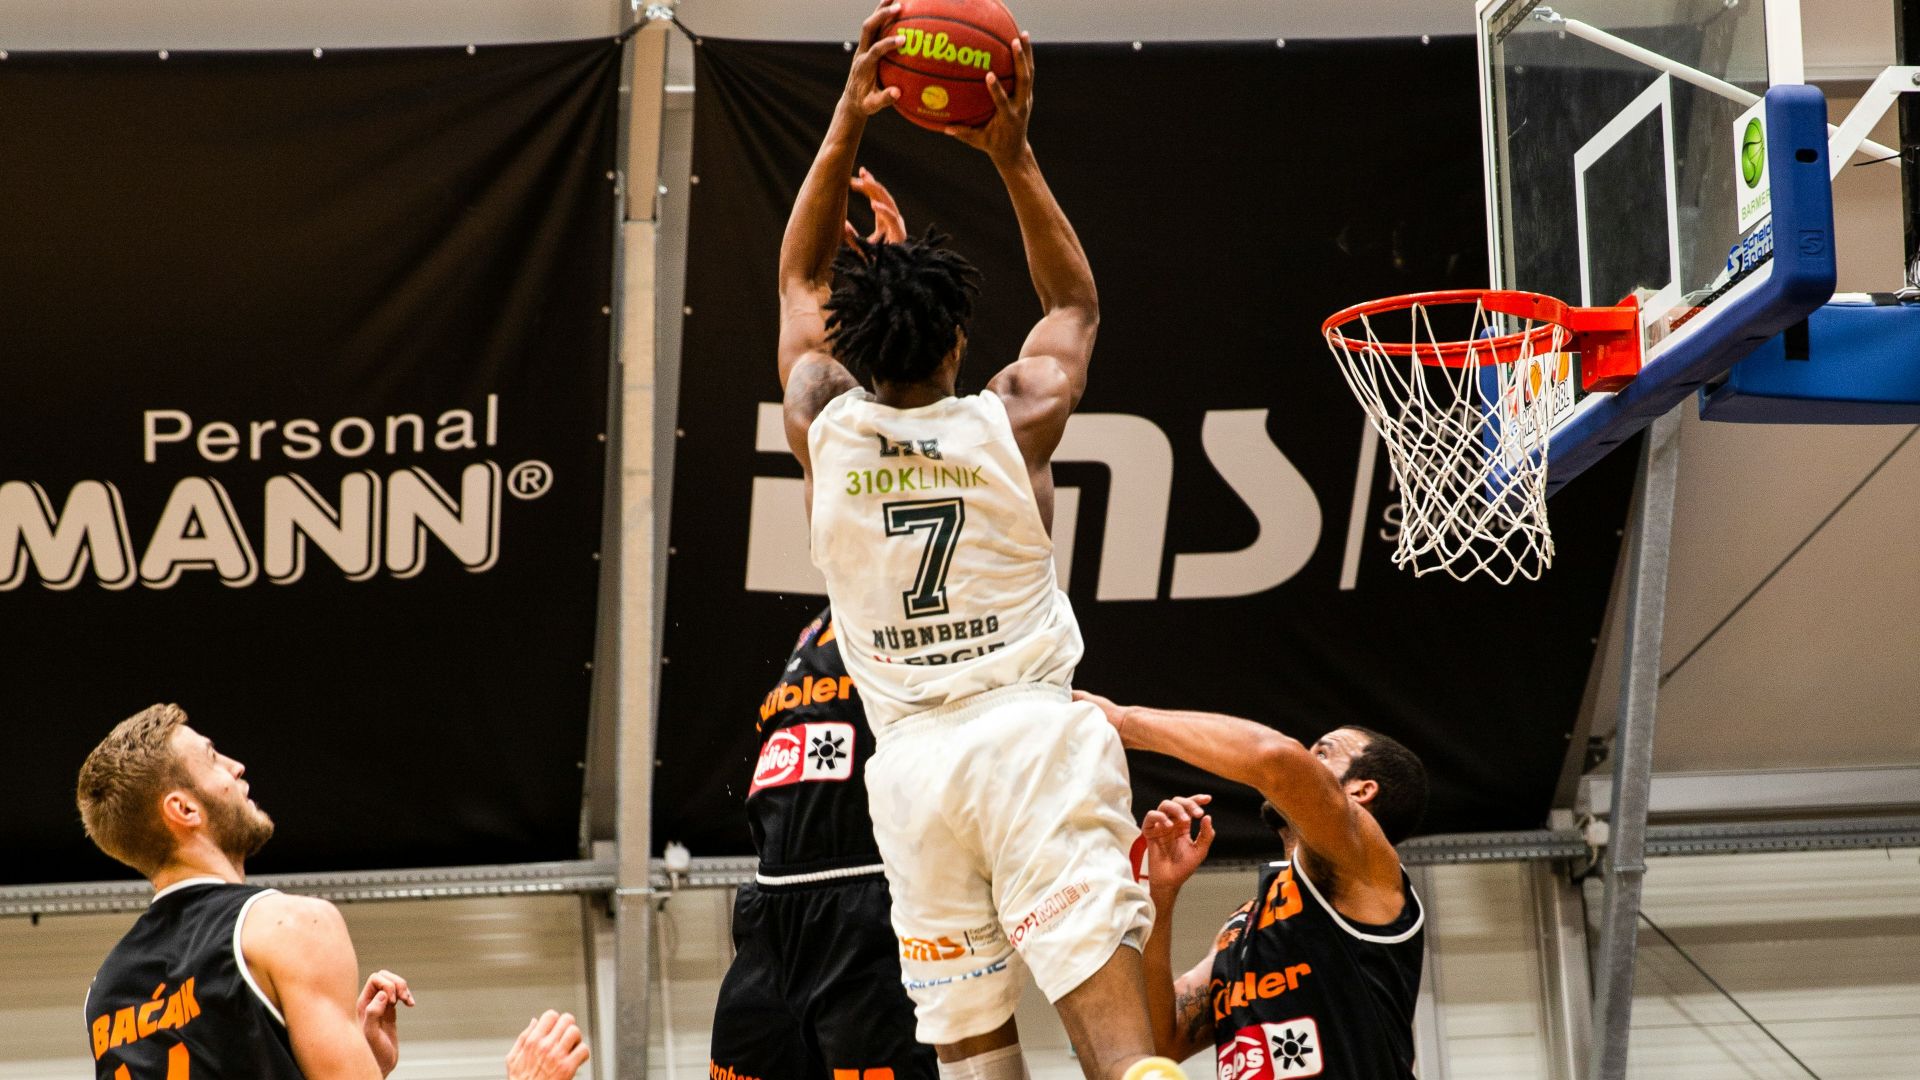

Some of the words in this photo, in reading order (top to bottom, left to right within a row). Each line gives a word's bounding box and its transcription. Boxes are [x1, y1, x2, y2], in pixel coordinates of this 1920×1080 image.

[896, 27, 992, 71] Wilson
[143, 393, 498, 463] Personal
[882, 496, 966, 620] 7
[872, 615, 999, 651] NÜRNBERG
